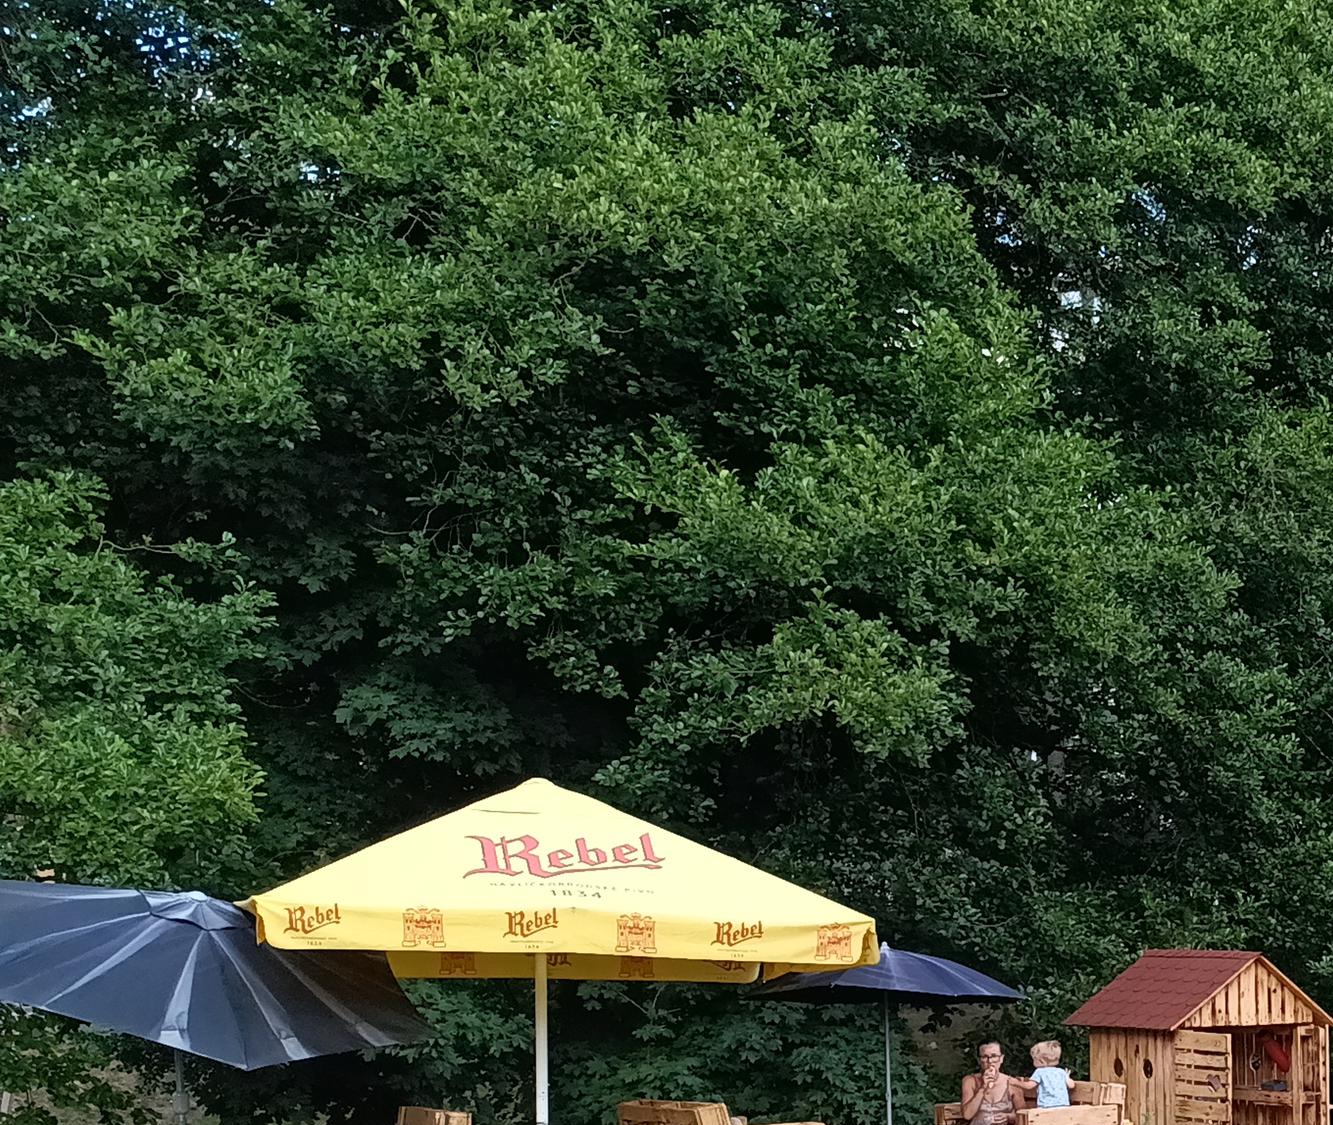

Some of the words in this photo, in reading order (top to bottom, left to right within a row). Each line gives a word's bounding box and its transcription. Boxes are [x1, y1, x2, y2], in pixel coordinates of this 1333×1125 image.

[463, 833, 666, 879] Rebel
[283, 903, 342, 935] Rebel
[502, 907, 559, 938] Rebel
[710, 920, 764, 947] Rebel
